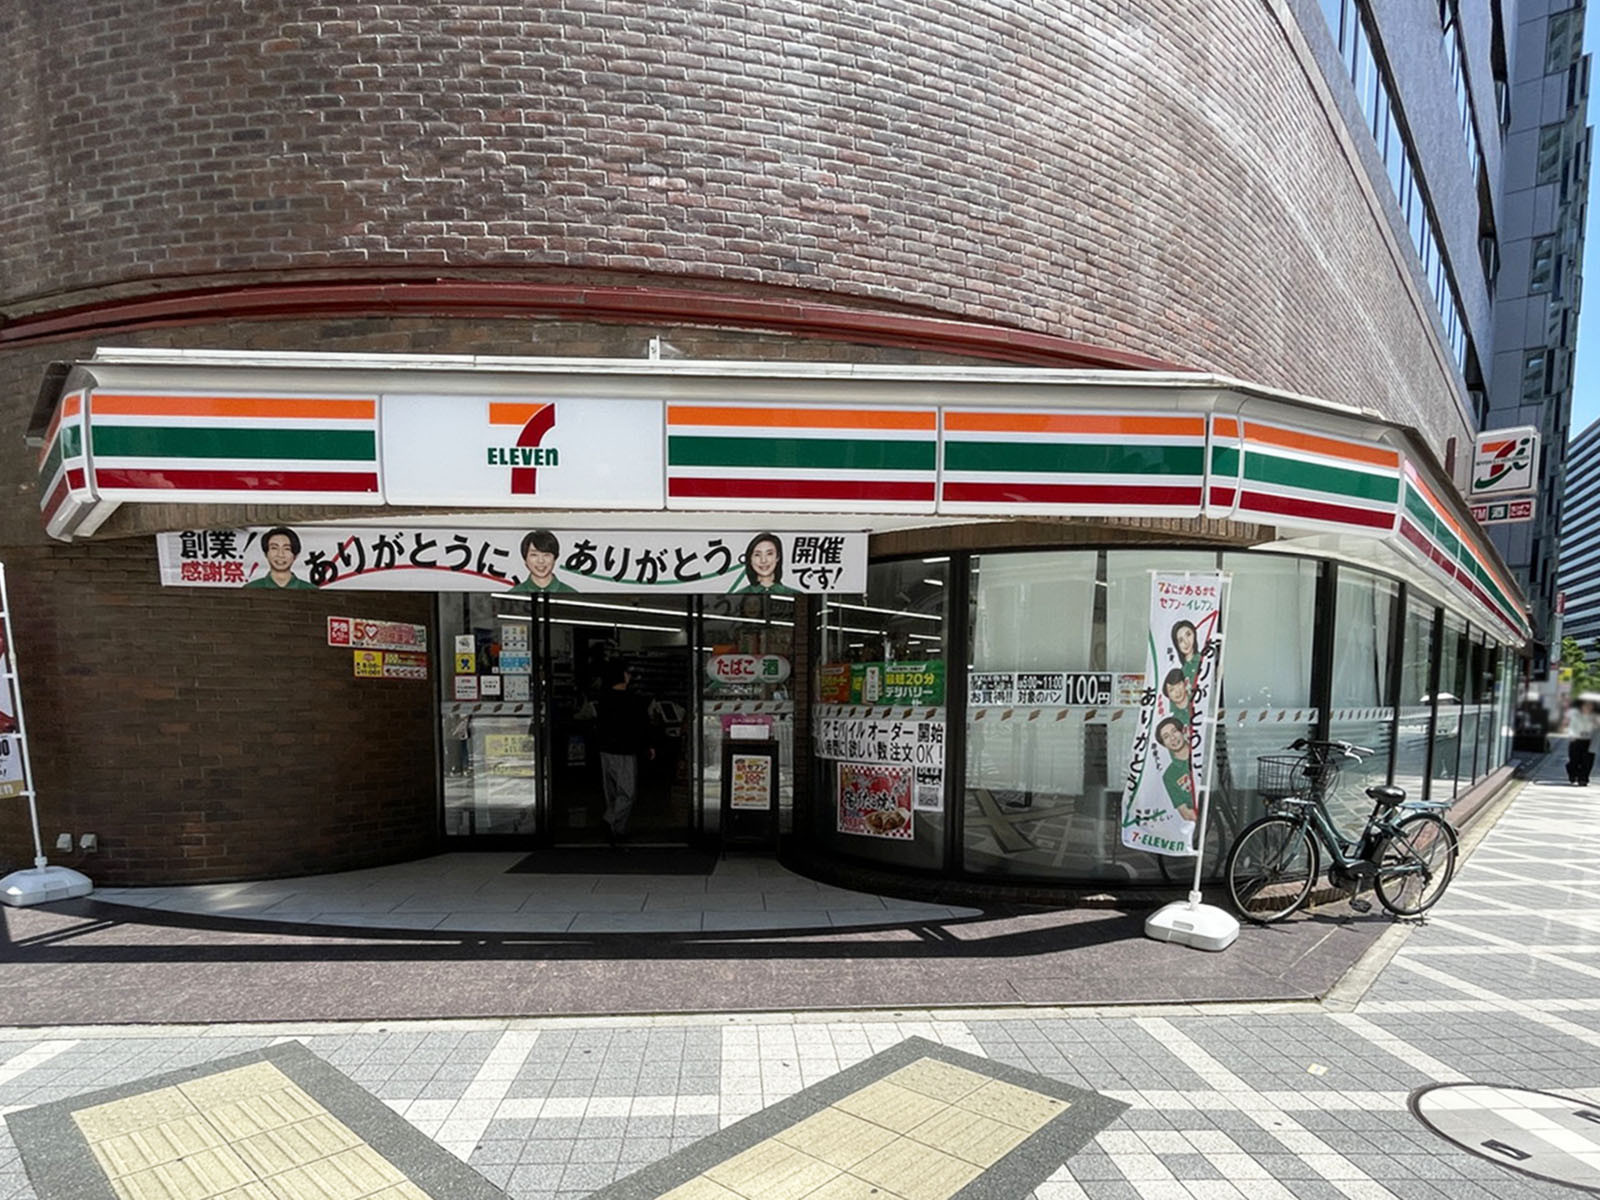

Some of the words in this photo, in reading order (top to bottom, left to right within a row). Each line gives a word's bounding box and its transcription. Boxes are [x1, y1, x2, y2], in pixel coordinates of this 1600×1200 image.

[792, 537, 845, 564] 開催
[181, 562, 260, 583] 感謝祭!
[792, 567, 843, 590] です!
[716, 658, 755, 675] たばこ
[762, 659, 779, 676] 酒
[885, 686, 933, 697] デリバリー
